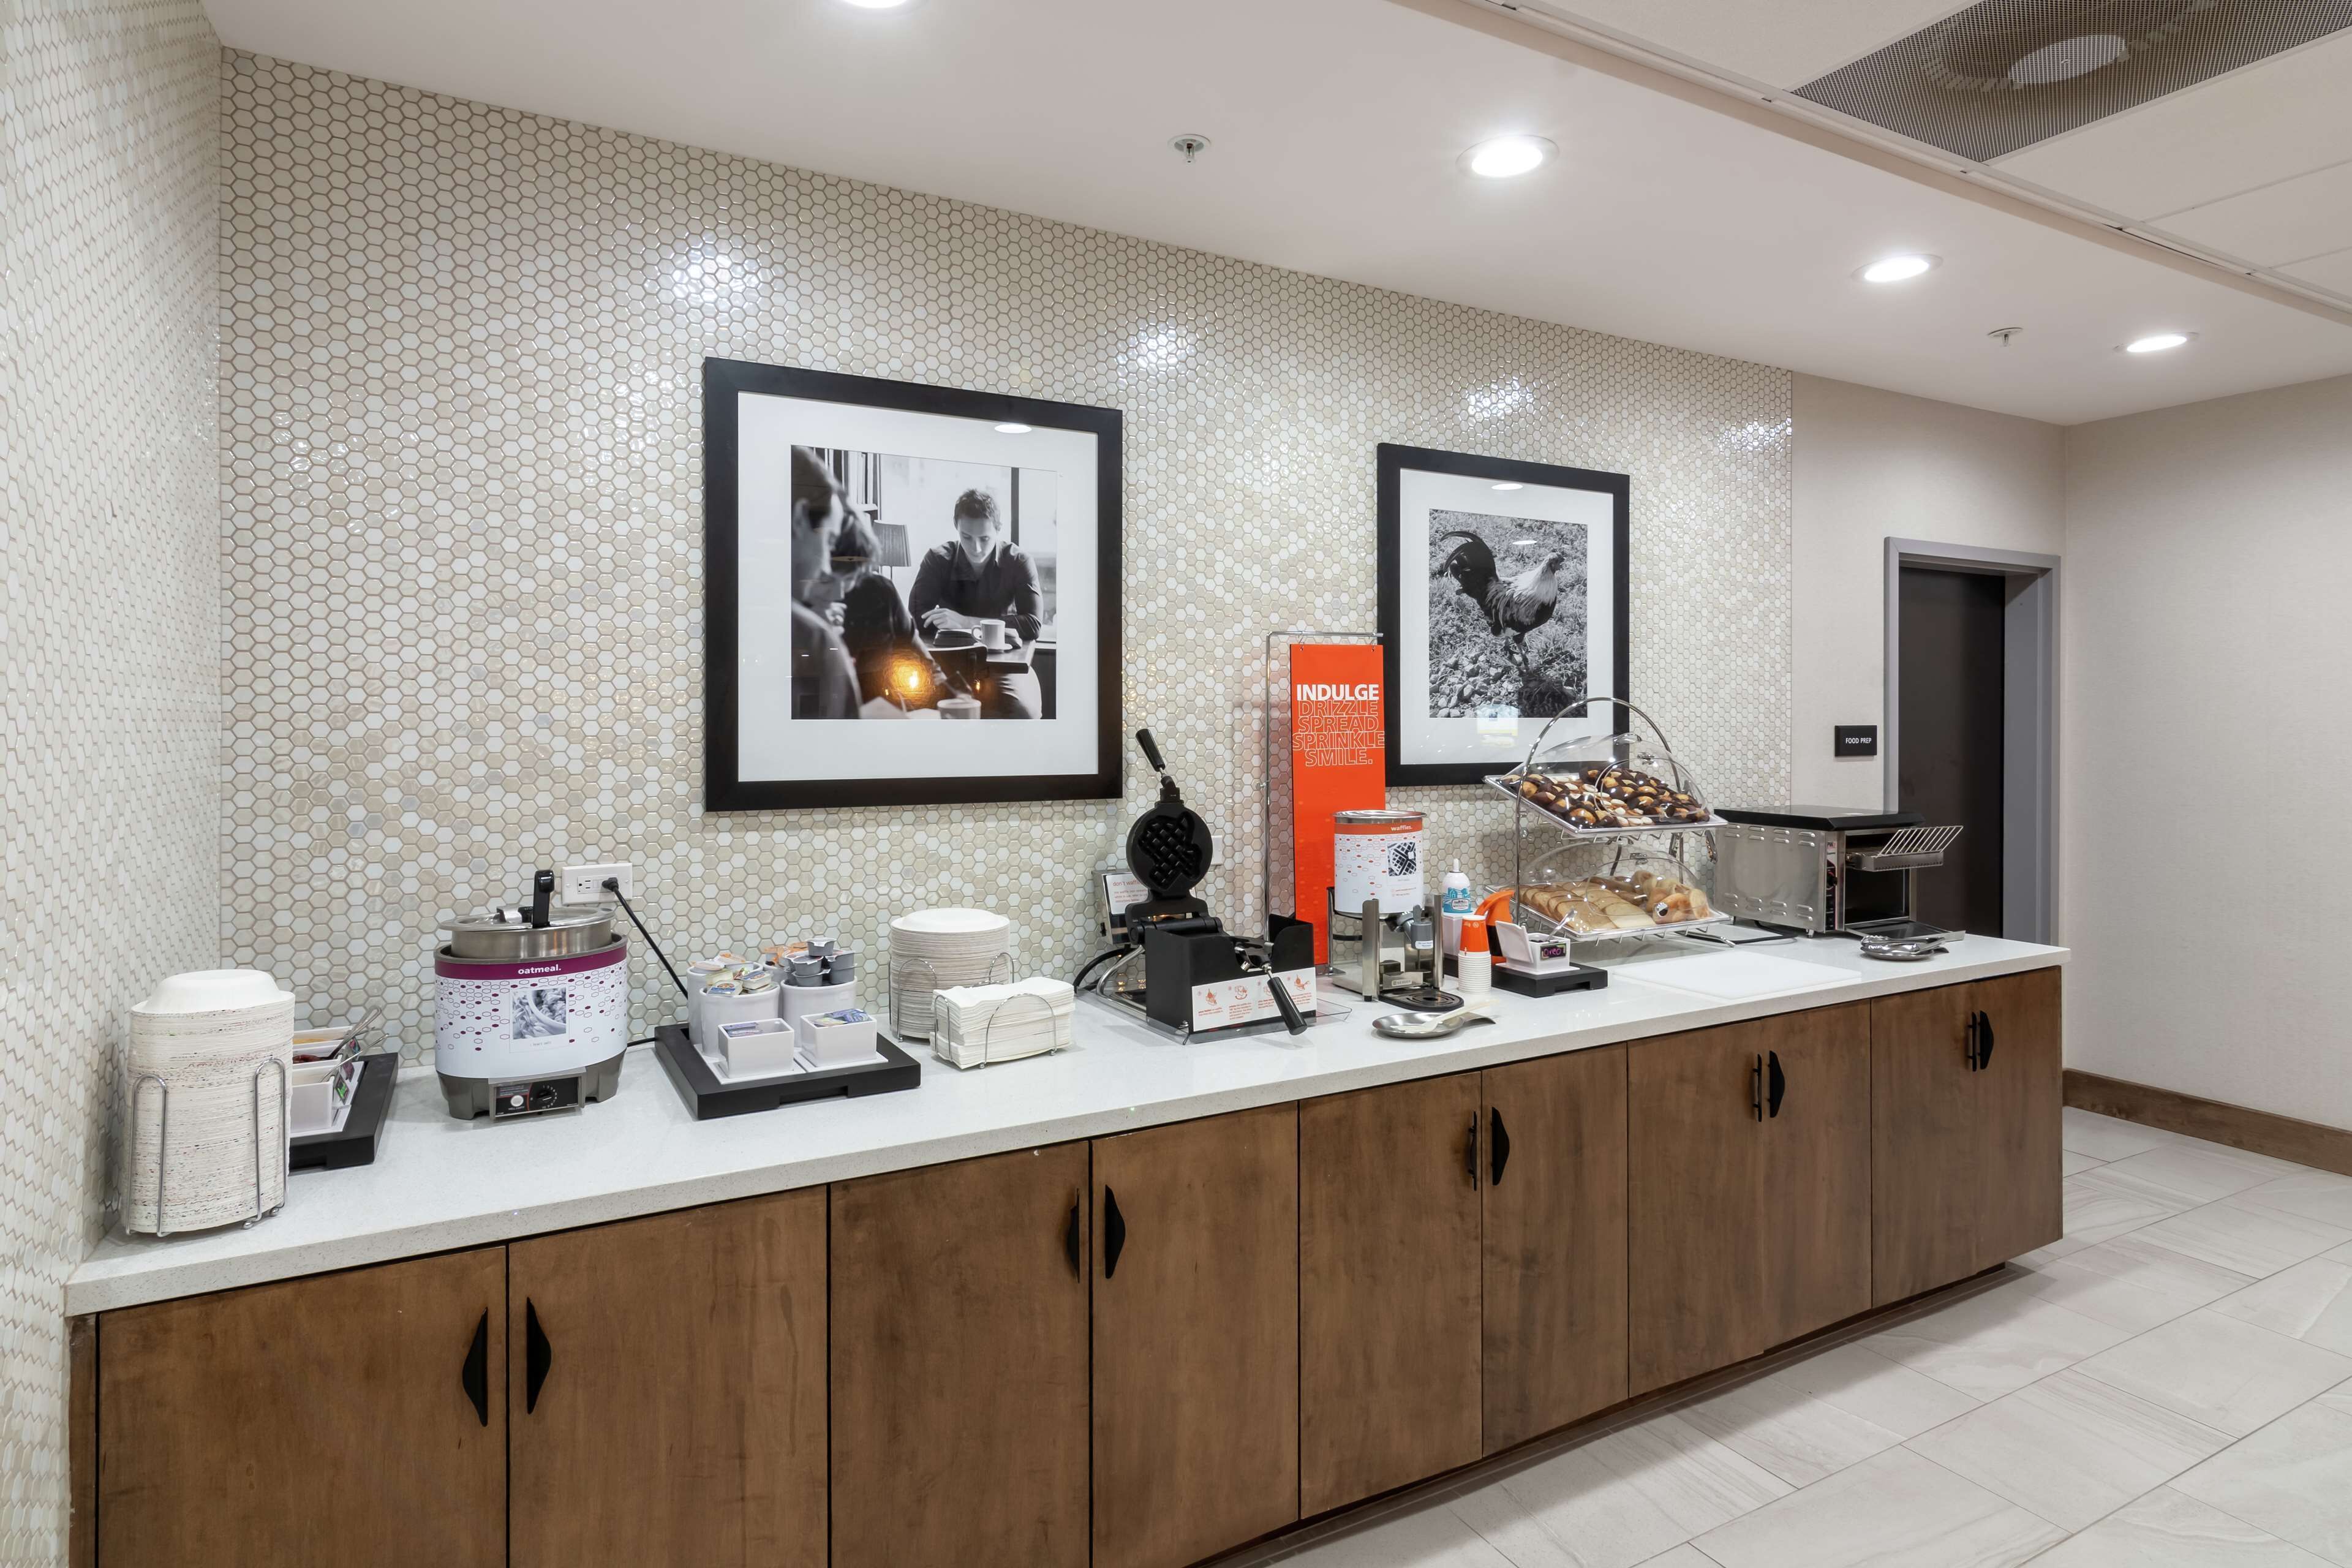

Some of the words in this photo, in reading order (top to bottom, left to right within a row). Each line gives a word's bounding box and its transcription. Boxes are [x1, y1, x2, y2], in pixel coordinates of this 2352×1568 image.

[1297, 684, 1379, 701] INDULGE
[1298, 699, 1378, 717] DRIZZLE
[1298, 715, 1379, 734] SPREAD
[1292, 731, 1385, 751] SPRINKLE
[1305, 748, 1373, 767] SMILE.
[1544, 948, 1562, 956] Oreo
[518, 964, 562, 974] oatmeal.
